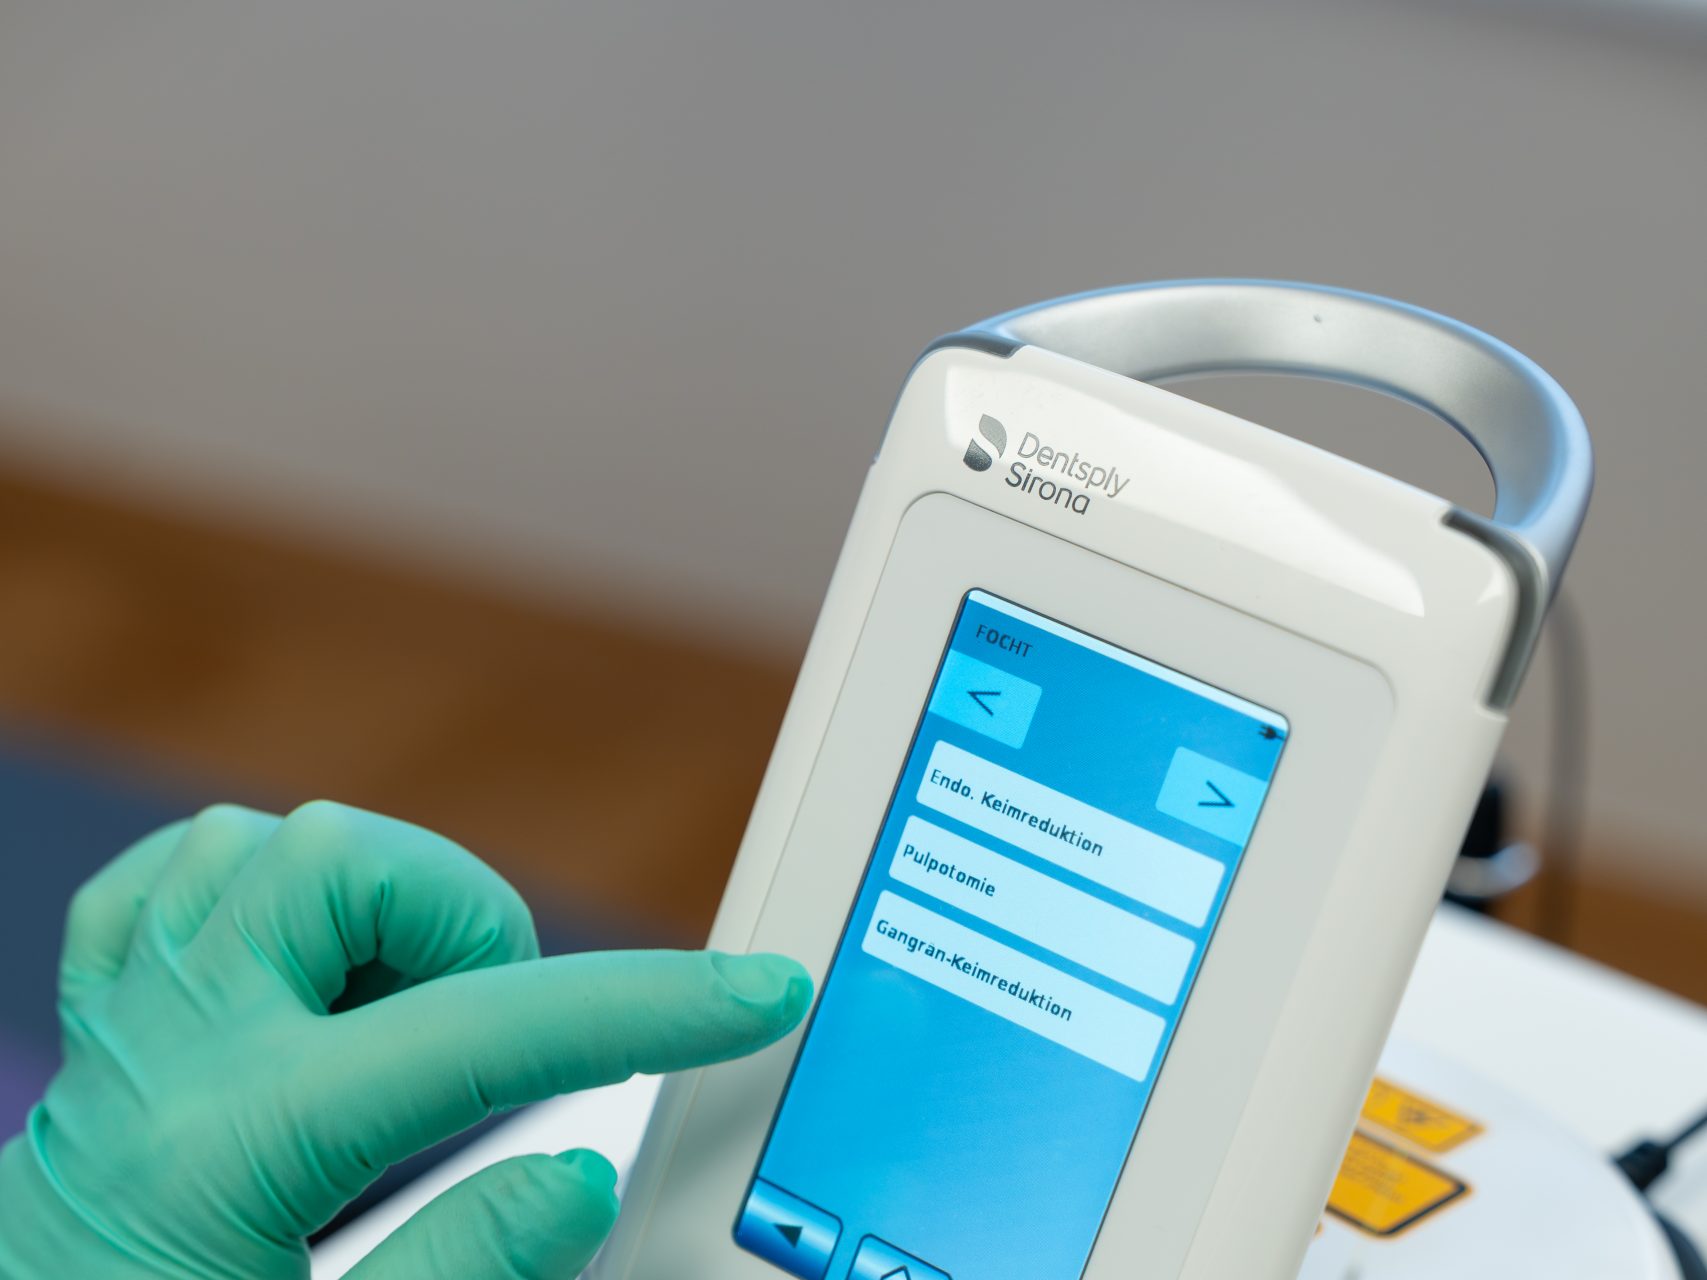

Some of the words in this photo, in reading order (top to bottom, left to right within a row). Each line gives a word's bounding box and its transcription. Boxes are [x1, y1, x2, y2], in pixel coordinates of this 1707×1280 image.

[1004, 461, 1091, 515] Sirona
[1017, 431, 1131, 498] Dentsply
[975, 624, 1033, 657] FOCHT
[929, 769, 974, 800] Endo.
[980, 790, 1104, 857] Keimreduktion
[902, 843, 996, 897] Pulpotomie
